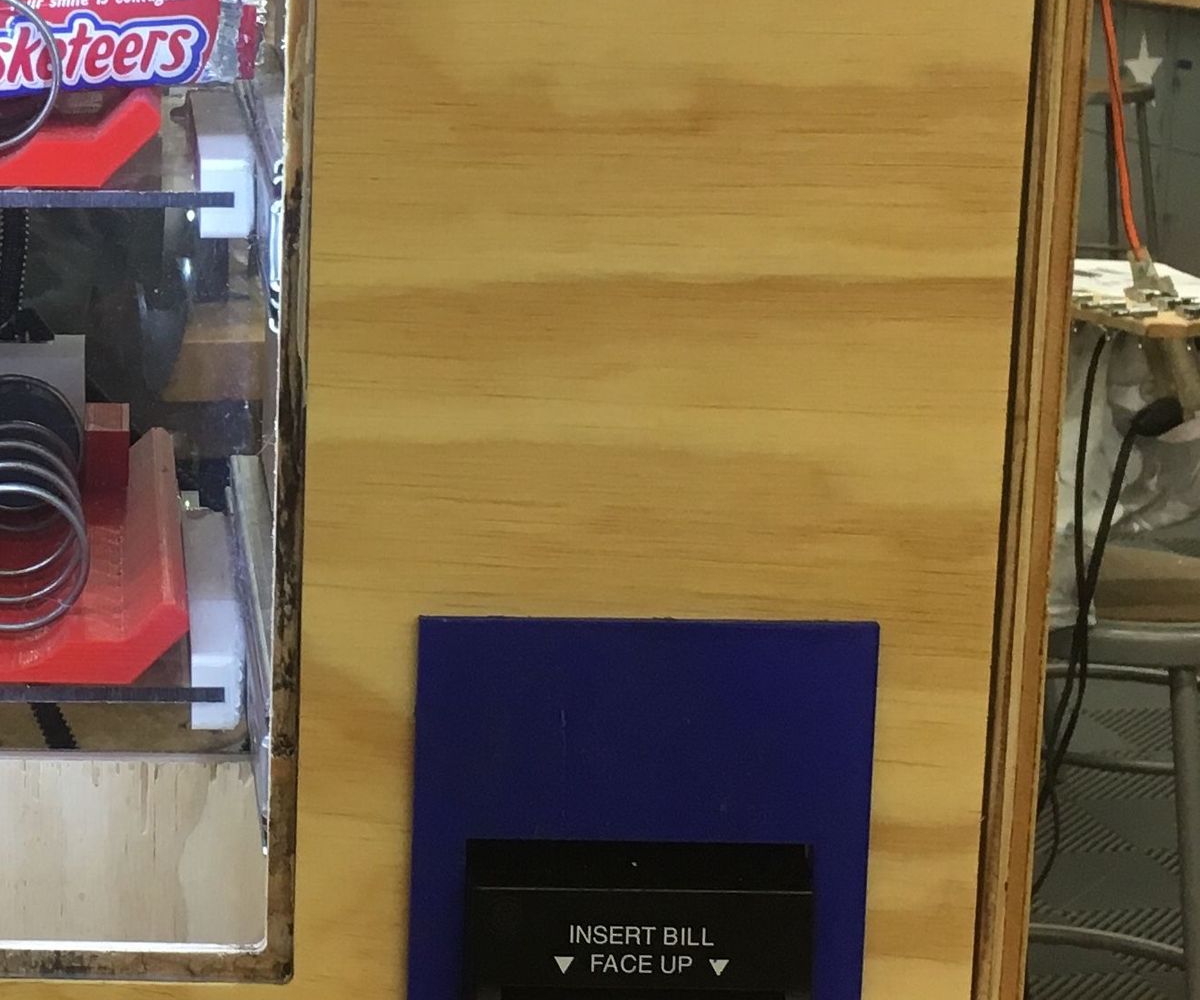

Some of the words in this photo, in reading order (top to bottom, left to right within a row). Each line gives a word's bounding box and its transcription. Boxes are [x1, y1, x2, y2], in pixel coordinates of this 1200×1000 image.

[569, 924, 656, 946] INSERT
[663, 927, 715, 947] BILL
[590, 954, 652, 974] FACE
[660, 956, 693, 974] UP
